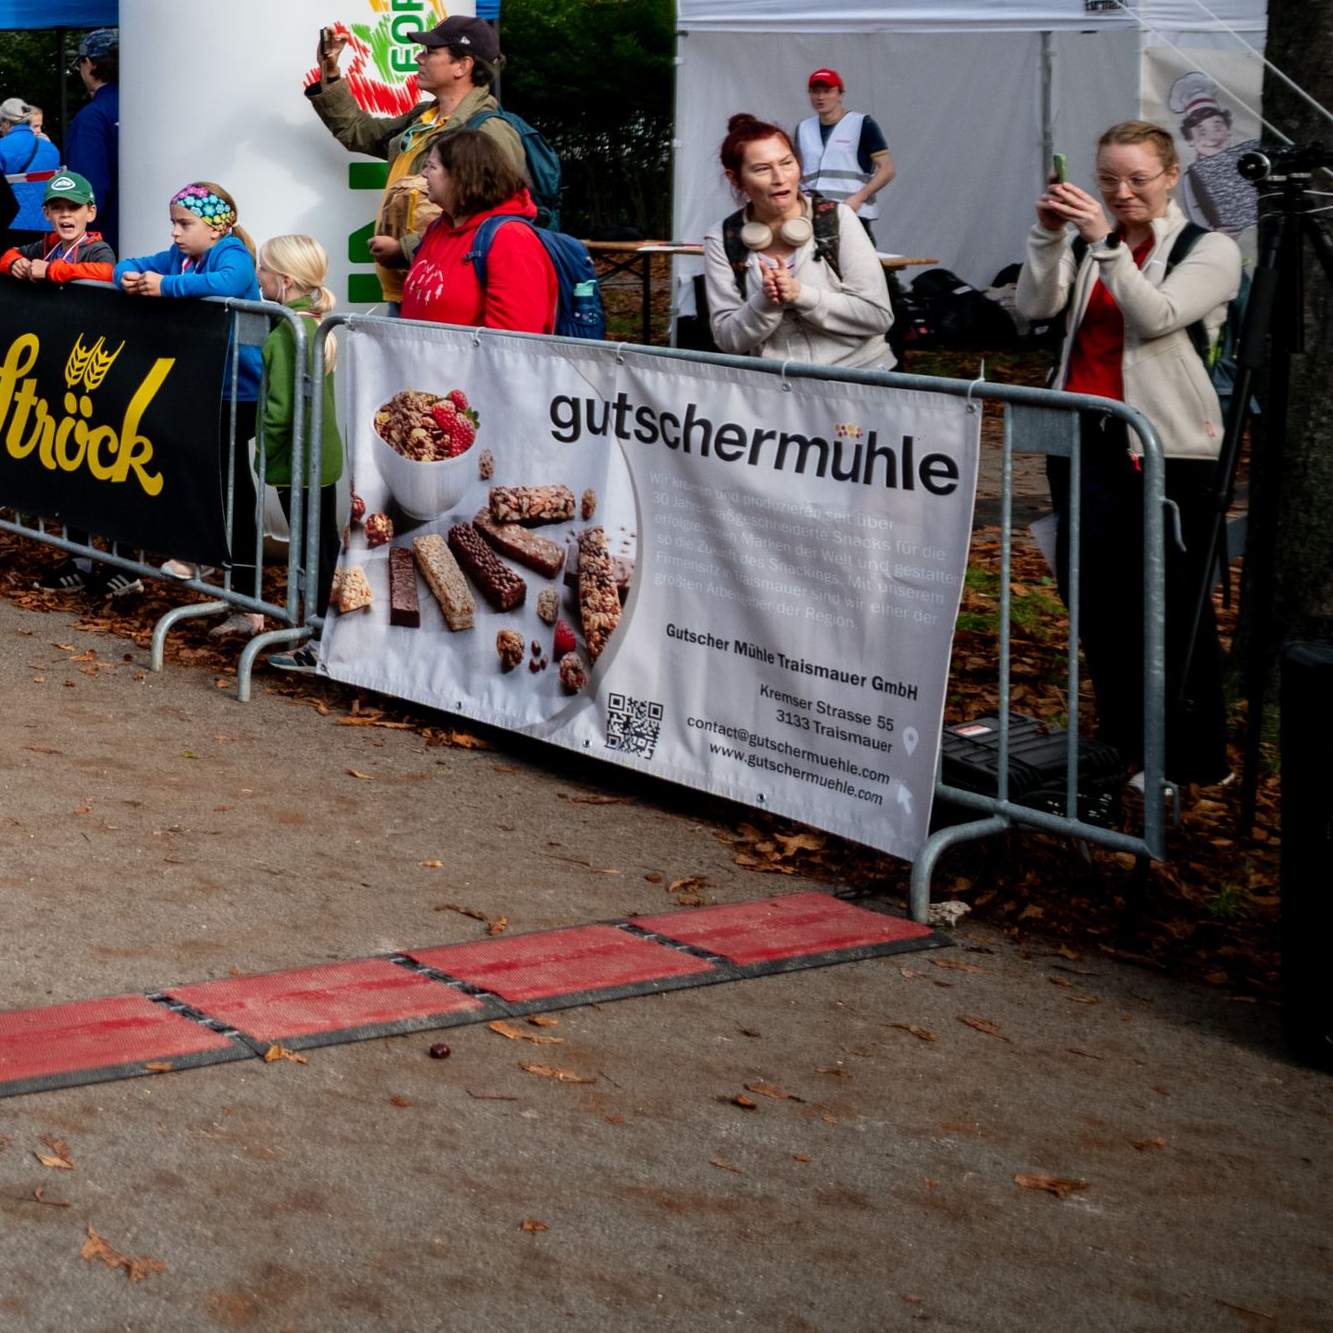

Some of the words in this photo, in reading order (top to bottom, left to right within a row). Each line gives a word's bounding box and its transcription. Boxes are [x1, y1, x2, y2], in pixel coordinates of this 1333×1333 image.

[549, 391, 960, 496] gutschermühle
[652, 490, 670, 506] 30
[833, 529, 892, 552] Snacks
[895, 538, 918, 555] für
[922, 546, 947, 561] die
[856, 509, 895, 532] über
[741, 531, 791, 553] Marken
[821, 549, 853, 567] Welt
[847, 574, 873, 592] Mit
[877, 581, 945, 605] unserem
[870, 600, 910, 619] einer
[666, 623, 731, 652] Gutscher
[733, 639, 775, 665] Mühle
[777, 653, 868, 688] Traismauer
[870, 675, 919, 701] GmbH
[759, 683, 813, 711] Kremser
[815, 700, 872, 726] Strasse
[876, 716, 895, 732] 55
[775, 709, 811, 731] 3133
[812, 720, 893, 754] Traismauer
[686, 716, 891, 785] contact@gutschermuehle.com
[709, 741, 884, 806] www.gutschermuehle.com
